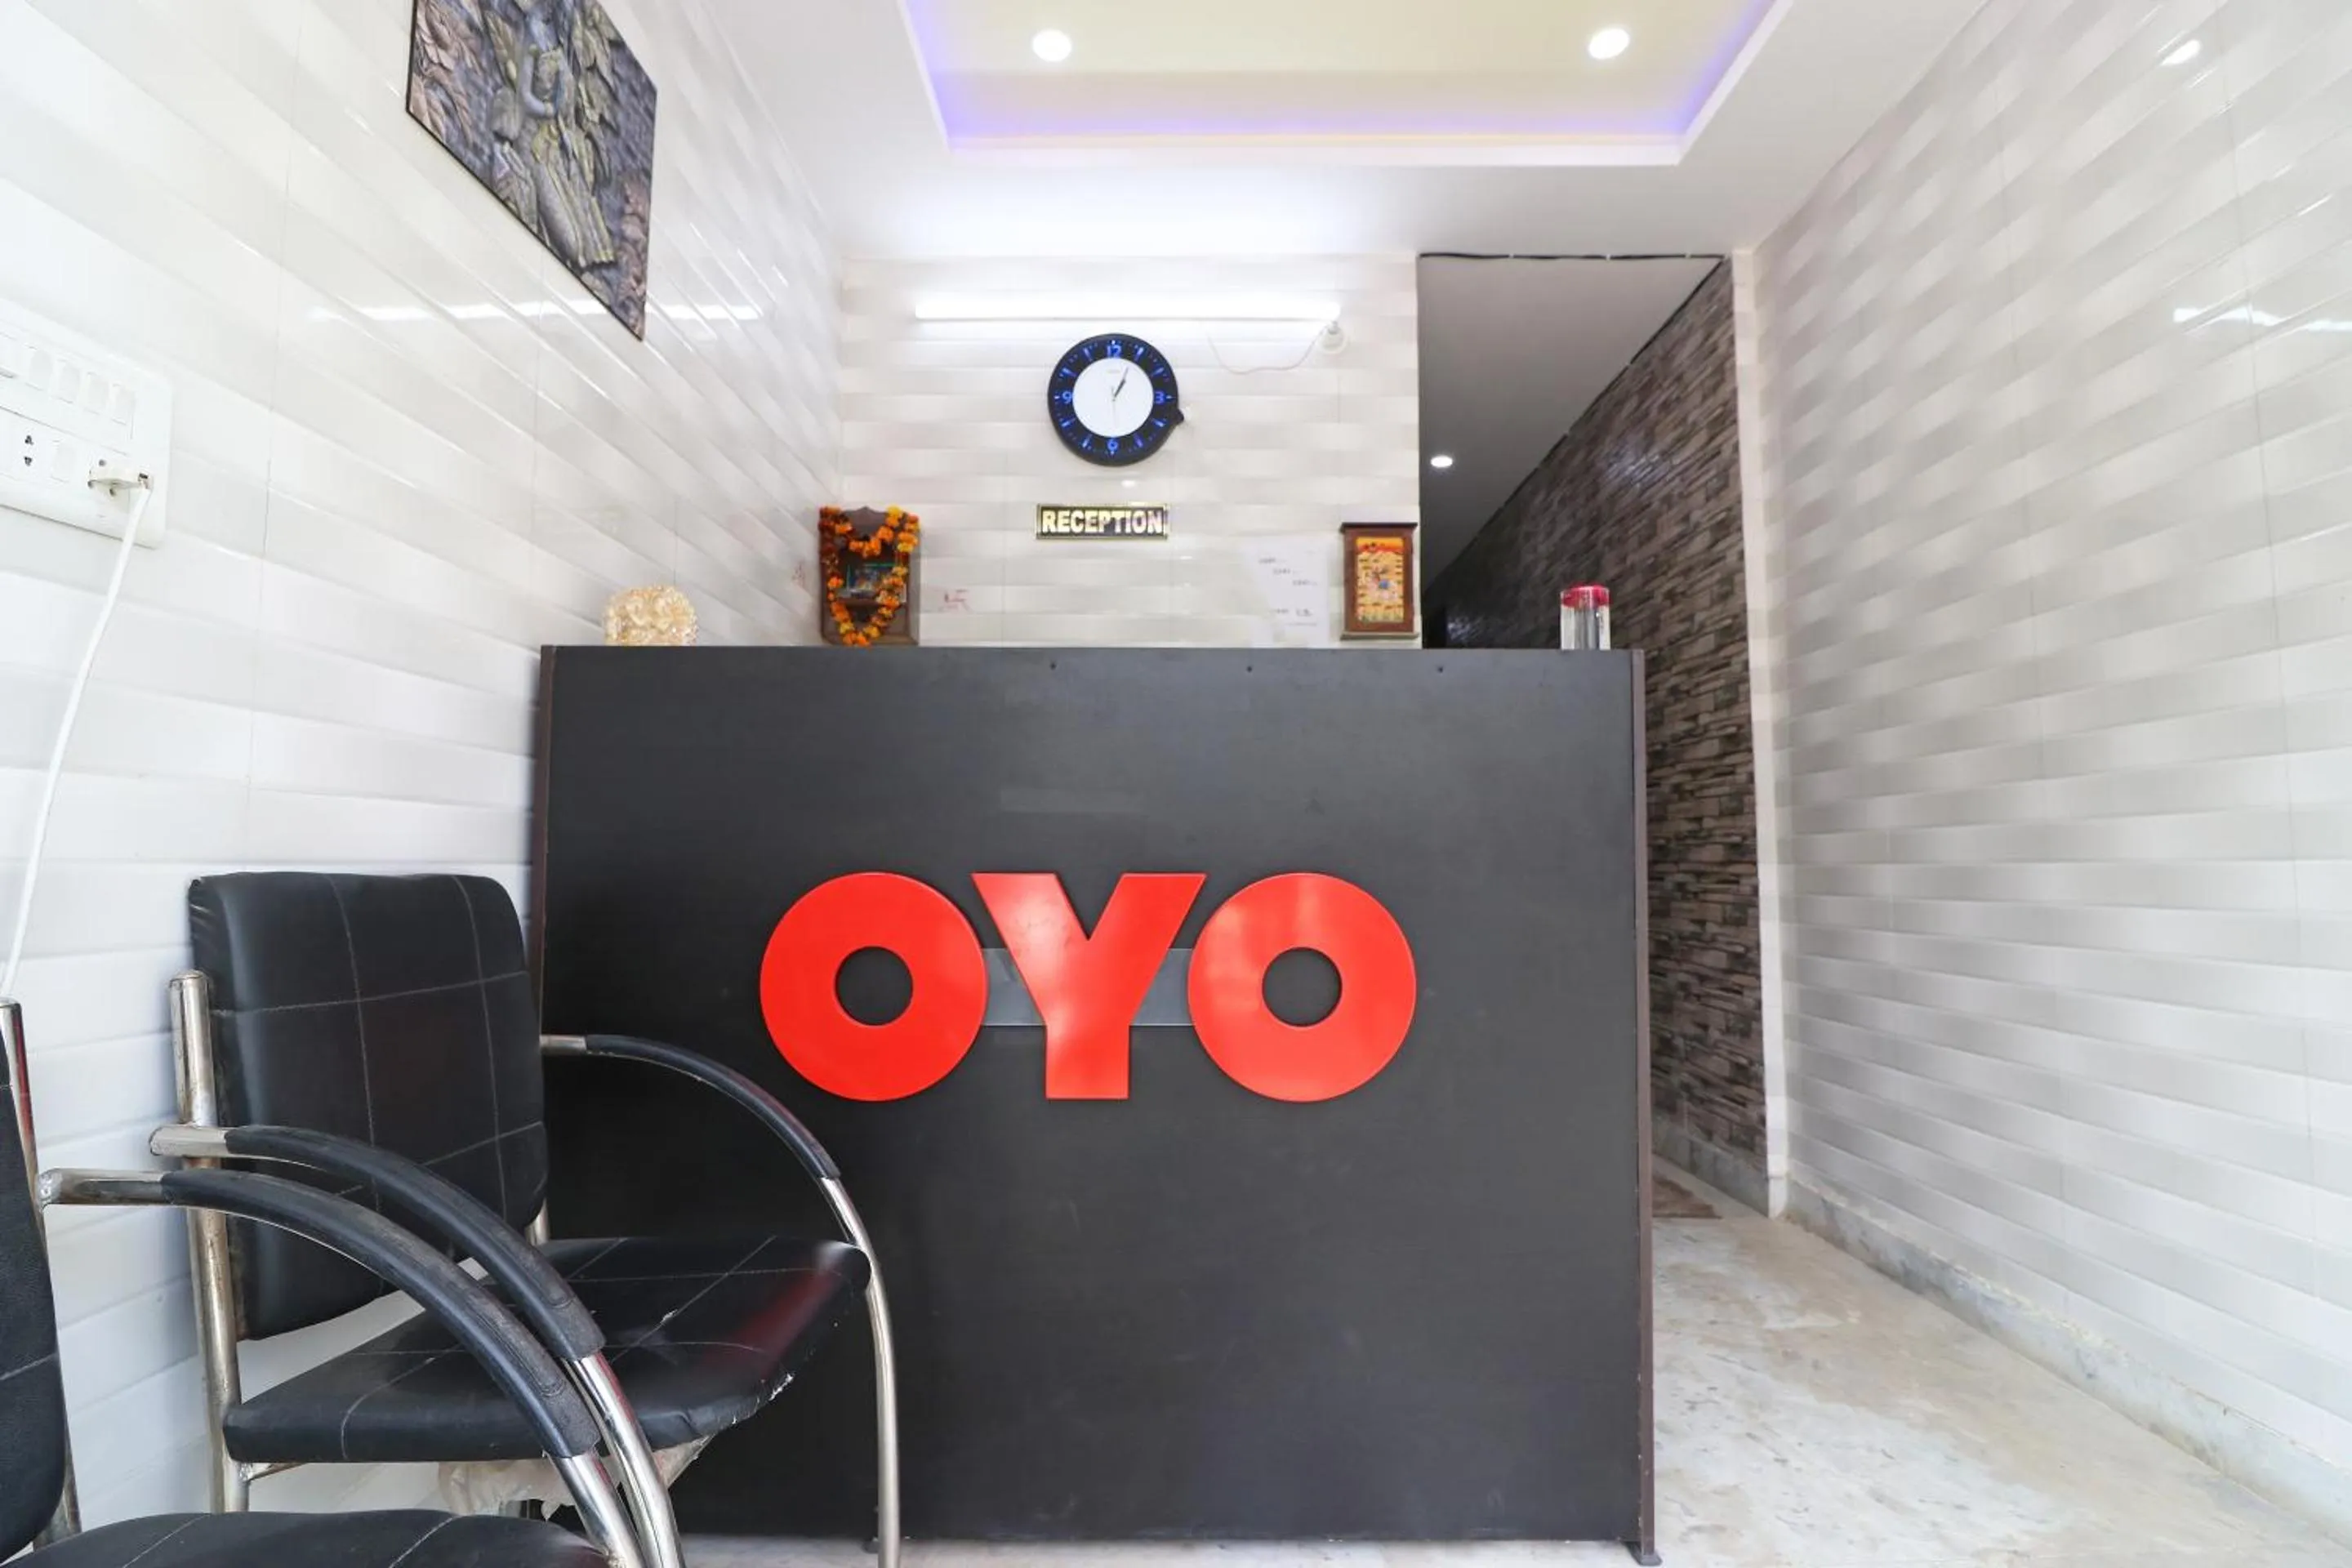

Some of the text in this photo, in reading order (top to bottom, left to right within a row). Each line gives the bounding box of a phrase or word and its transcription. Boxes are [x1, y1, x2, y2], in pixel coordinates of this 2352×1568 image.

[1107, 345, 1122, 359] 12
[1062, 391, 1073, 404] 9
[1155, 391, 1165, 404] 3
[1107, 437, 1119, 450] 6
[1041, 510, 1163, 534] RECEPTION
[760, 871, 1417, 1102] OYO
